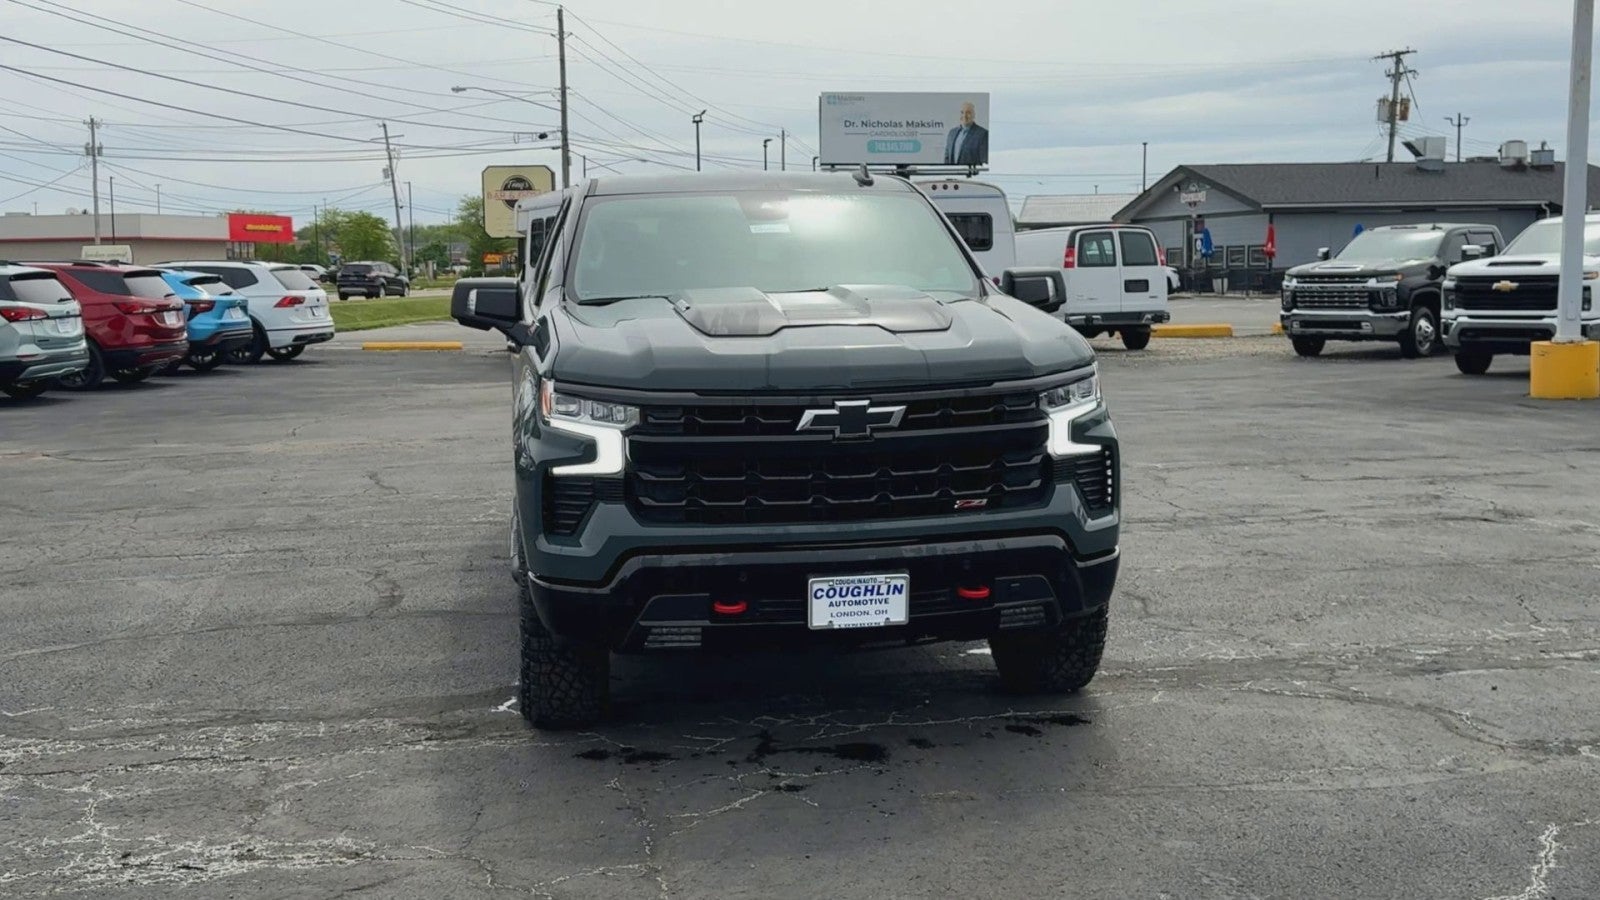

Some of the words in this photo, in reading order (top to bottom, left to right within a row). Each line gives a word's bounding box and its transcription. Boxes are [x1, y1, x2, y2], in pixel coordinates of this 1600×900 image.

[844, 120, 859, 128] Dr.
[861, 119, 904, 129] Nicholas
[906, 119, 944, 129] Maksim
[813, 584, 905, 600] COUGHLIN
[828, 598, 890, 608] AUTOMOTIVE
